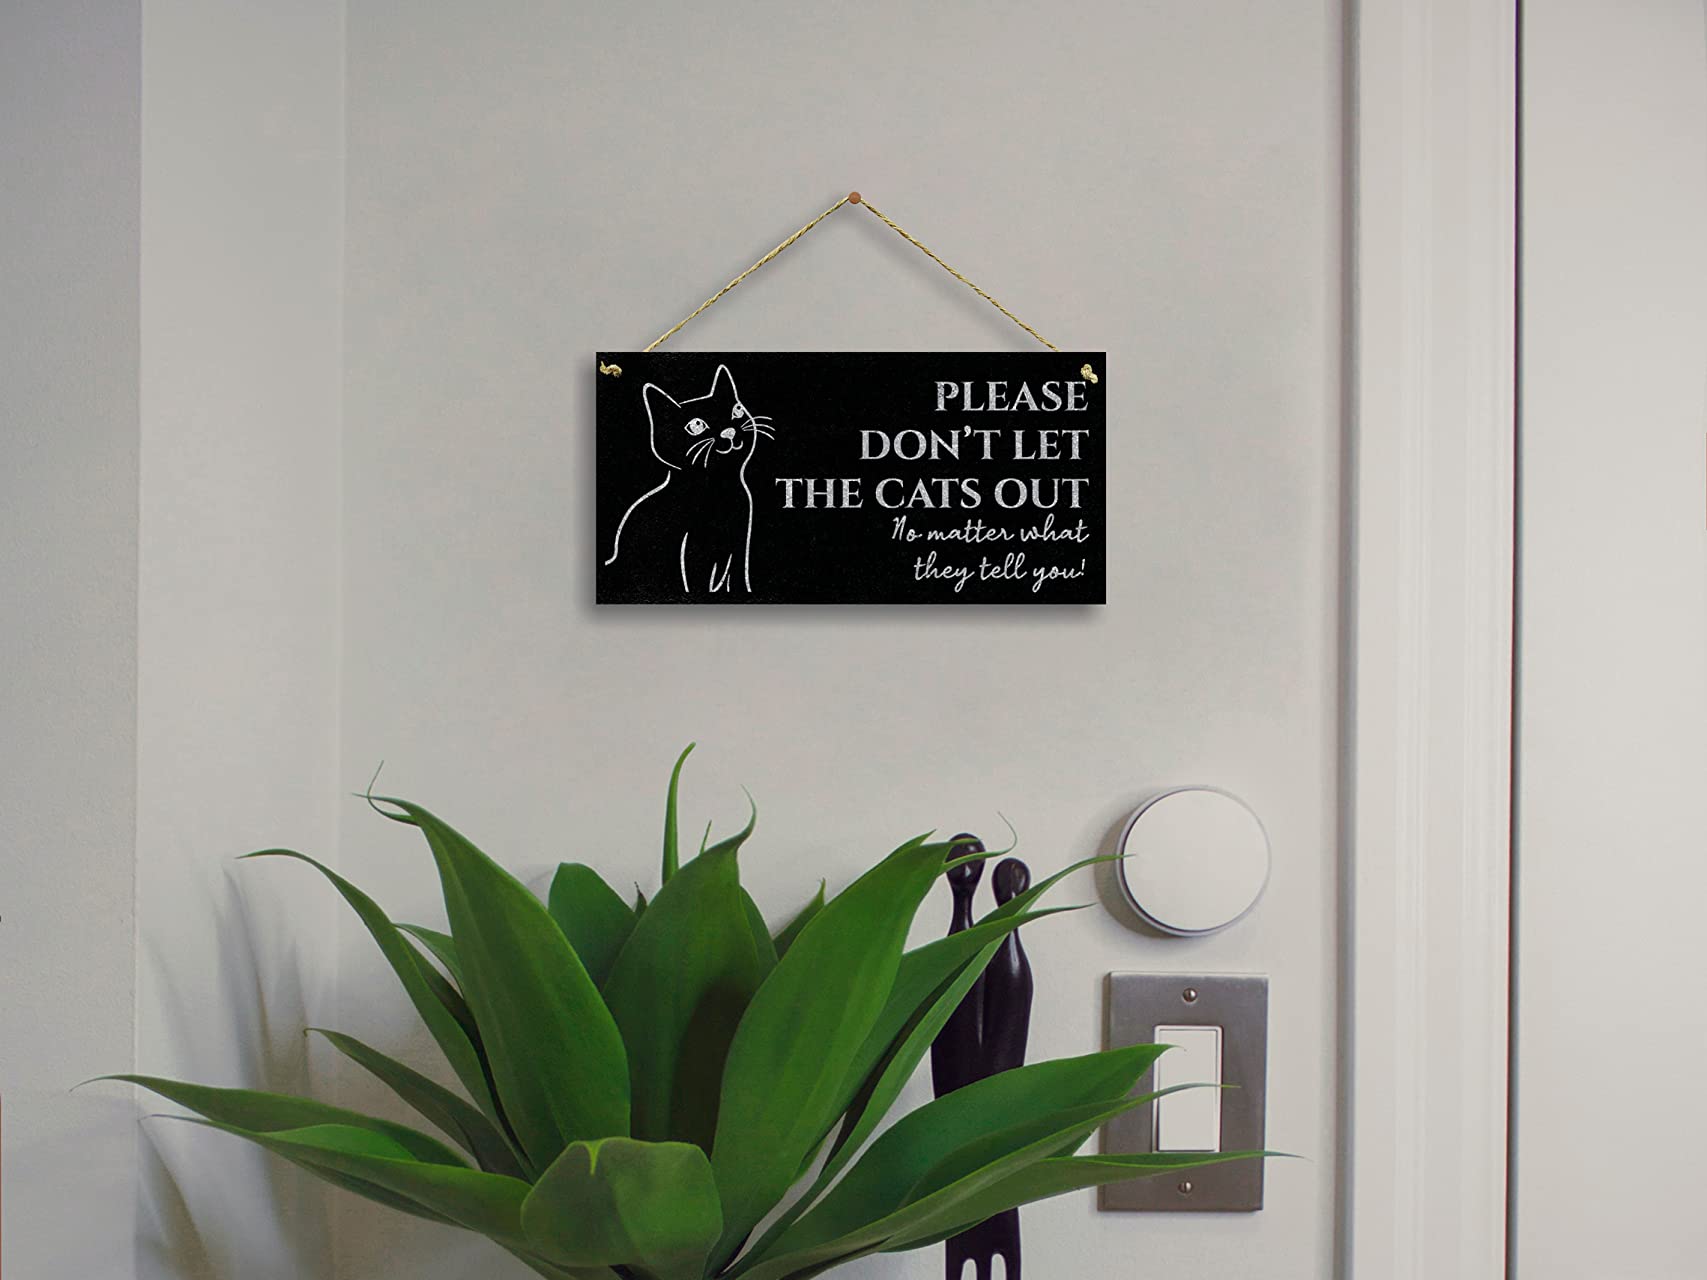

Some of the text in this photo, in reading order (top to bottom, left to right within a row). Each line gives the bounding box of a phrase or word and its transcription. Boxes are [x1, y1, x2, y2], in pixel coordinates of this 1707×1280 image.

[935, 381, 1089, 412] PLEASE
[1013, 429, 1090, 460] LET
[775, 477, 1090, 509] THE CATS OUT
[891, 513, 1090, 543] No matter what
[913, 551, 1086, 593] they tell you!
